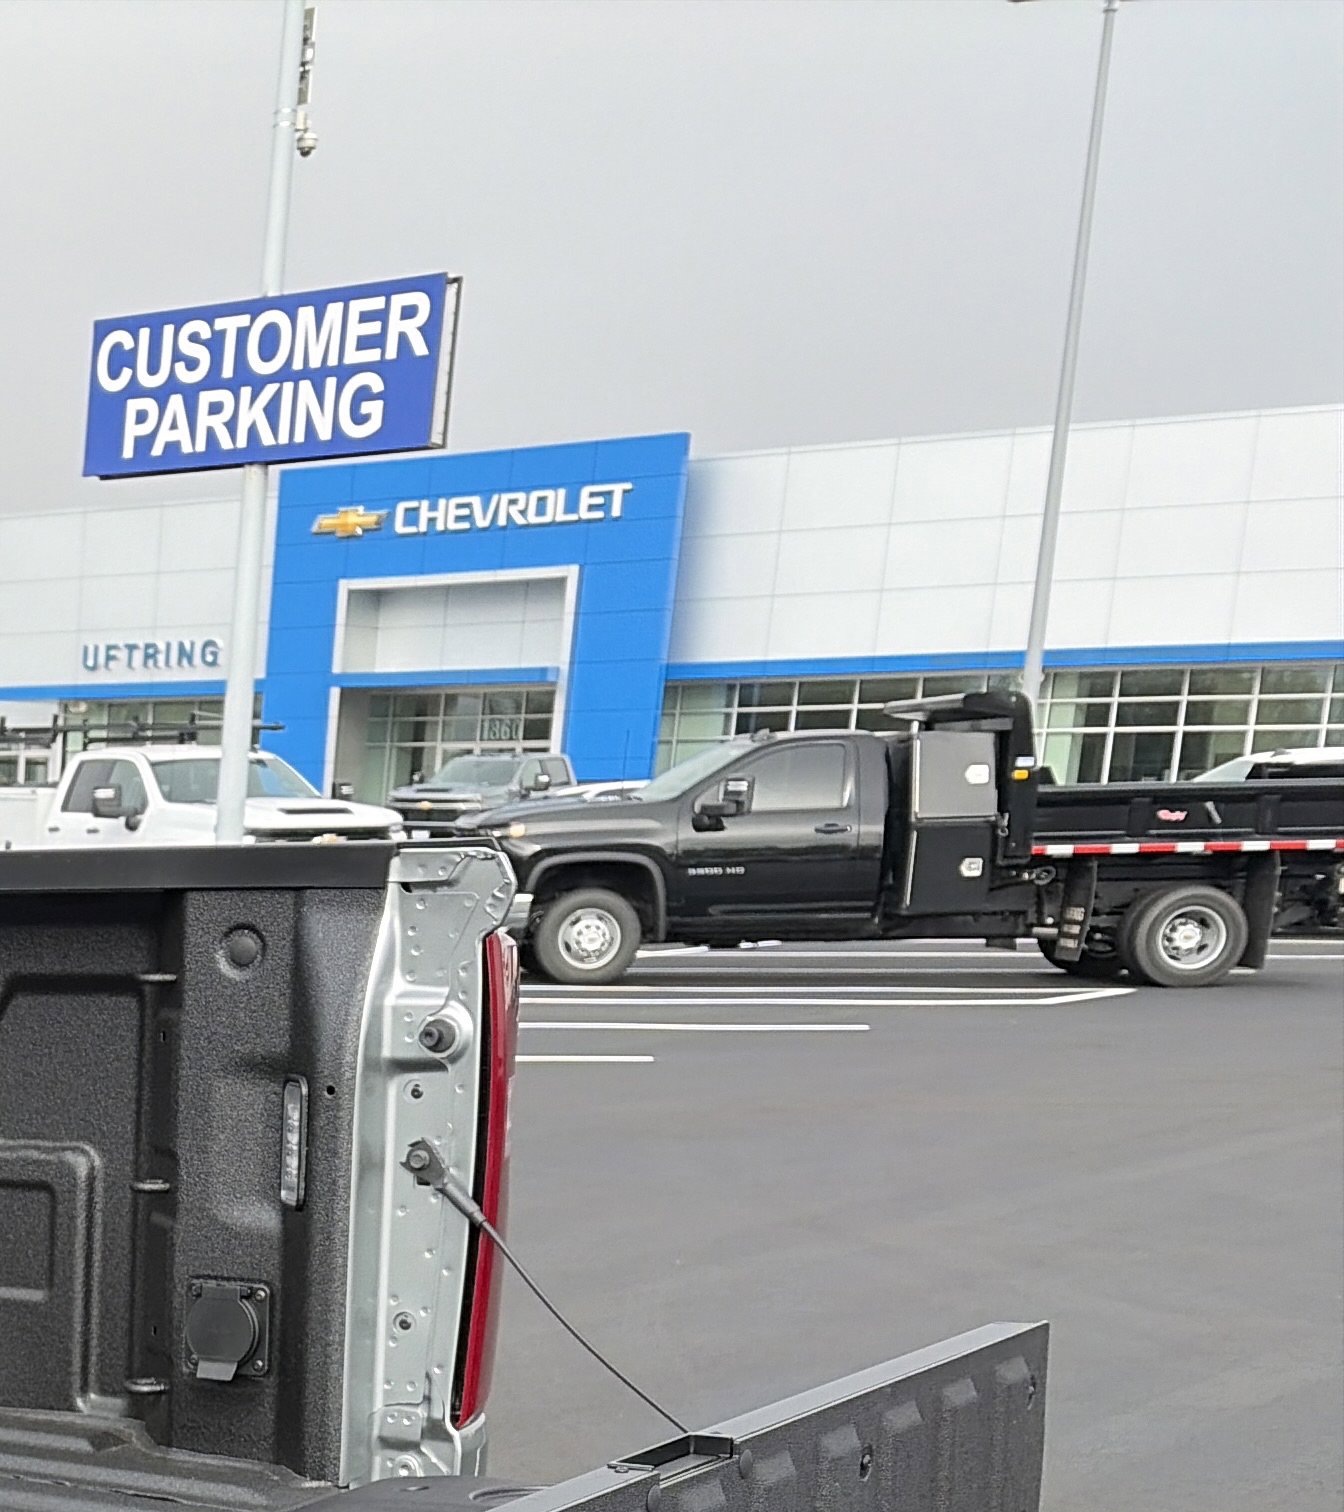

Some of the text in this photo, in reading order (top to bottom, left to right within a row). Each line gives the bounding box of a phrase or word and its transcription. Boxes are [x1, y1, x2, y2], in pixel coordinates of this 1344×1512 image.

[96, 290, 431, 392] CUSTOMER
[121, 371, 385, 460] PARKING
[395, 482, 633, 534] CHEVROLET
[82, 638, 221, 671] UFTRING
